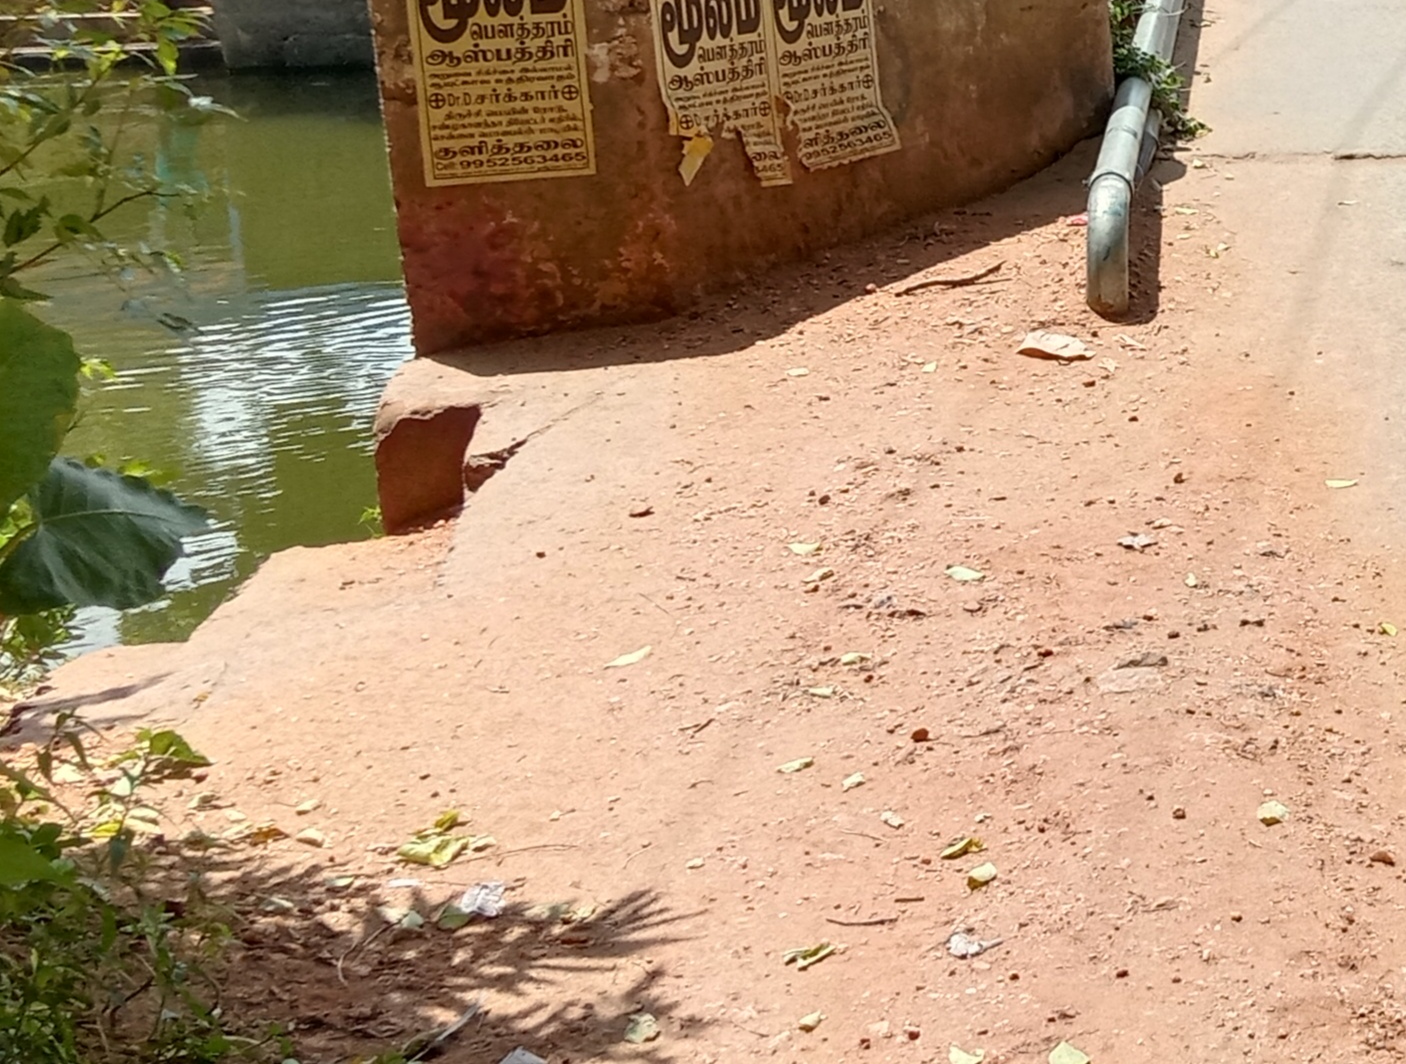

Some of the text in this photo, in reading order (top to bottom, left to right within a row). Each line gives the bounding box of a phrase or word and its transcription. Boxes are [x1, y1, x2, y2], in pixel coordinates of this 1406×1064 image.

[425, 38, 575, 67] ஆஸ்பத்திரி
[779, 31, 869, 66] ஆஸ்பத்திரி
[667, 57, 766, 92] ஆஸ்பத்திரி
[434, 137, 584, 161] குளித்தலை
[459, 151, 588, 169] 9952563465
